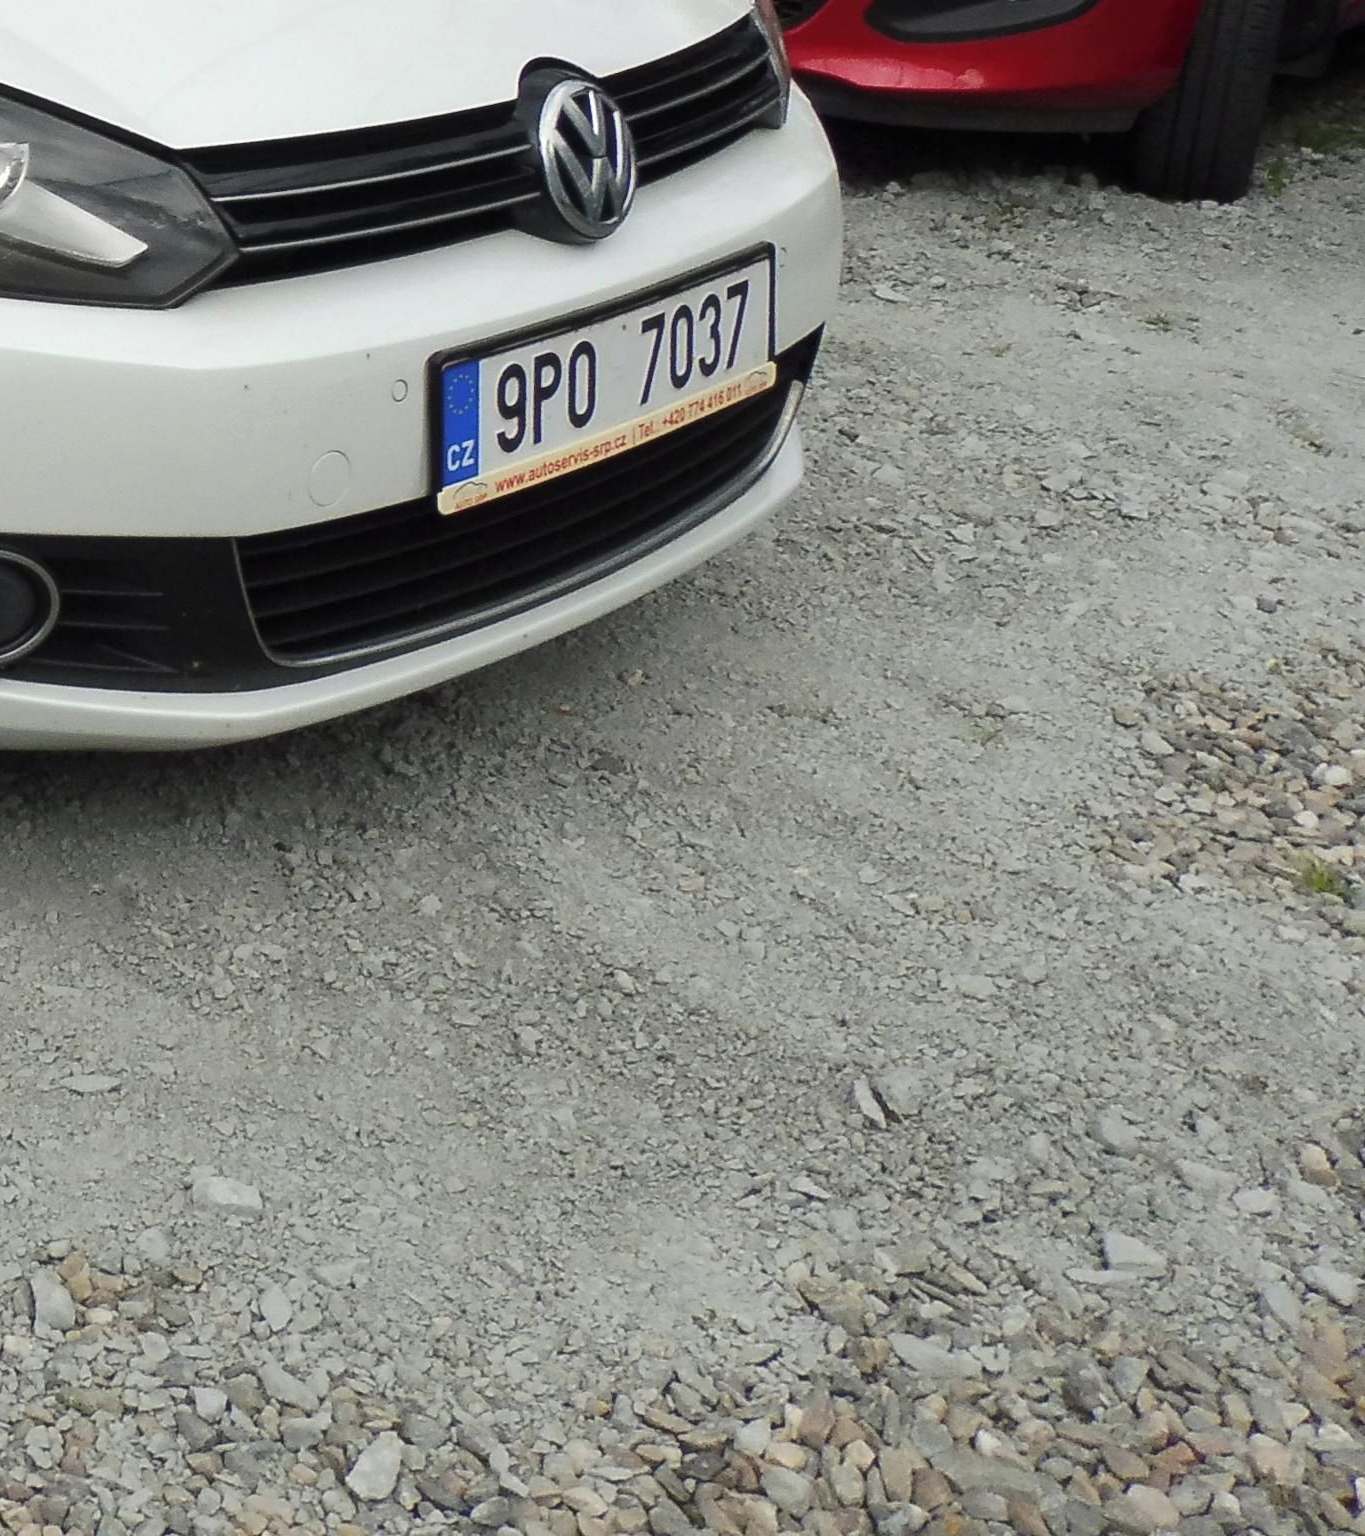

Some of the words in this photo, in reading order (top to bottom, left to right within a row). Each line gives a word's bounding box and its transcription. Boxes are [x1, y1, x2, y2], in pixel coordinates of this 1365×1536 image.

[640, 280, 750, 406] 7037
[447, 439, 475, 471] CZ
[494, 434, 628, 493] www.autoservis-srp.cz
